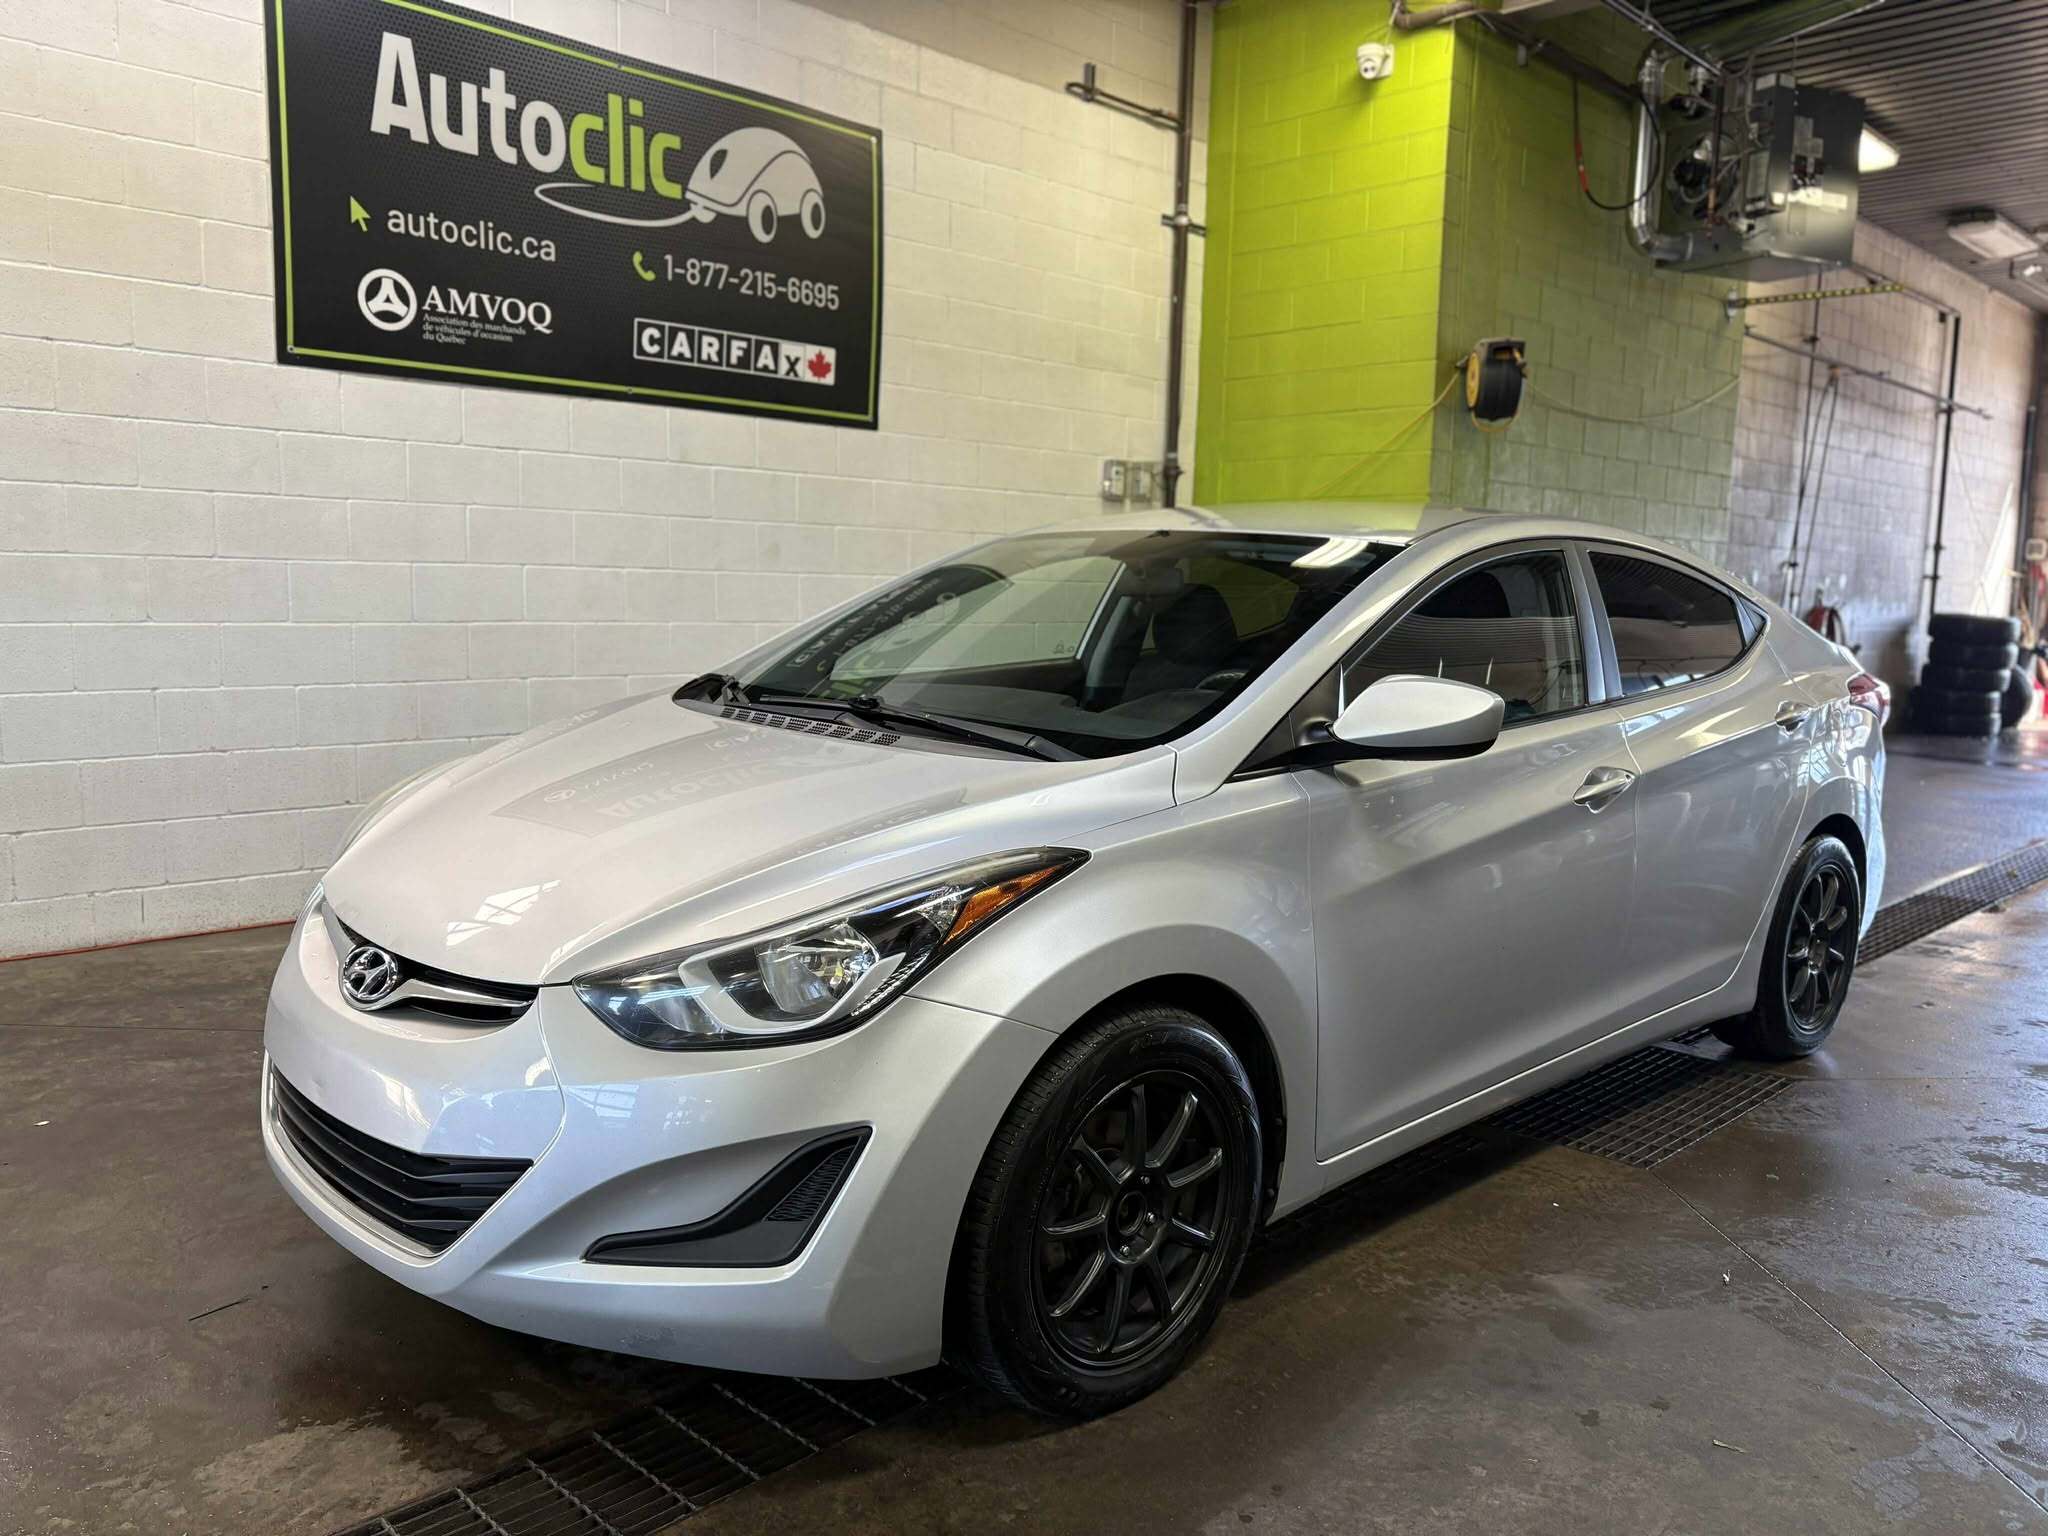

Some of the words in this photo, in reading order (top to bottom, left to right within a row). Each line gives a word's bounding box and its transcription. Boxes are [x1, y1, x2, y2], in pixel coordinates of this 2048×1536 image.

[370, 31, 682, 200] Autoclic
[387, 209, 556, 262] autoclic.ca
[664, 254, 839, 310] 1-877-215-6695
[422, 285, 553, 334] AMVOQ
[422, 321, 433, 331] de
[423, 313, 469, 327] Association
[469, 320, 483, 329] des
[484, 323, 526, 336] marchands
[422, 331, 434, 340] du
[641, 327, 800, 378] CARFAX
